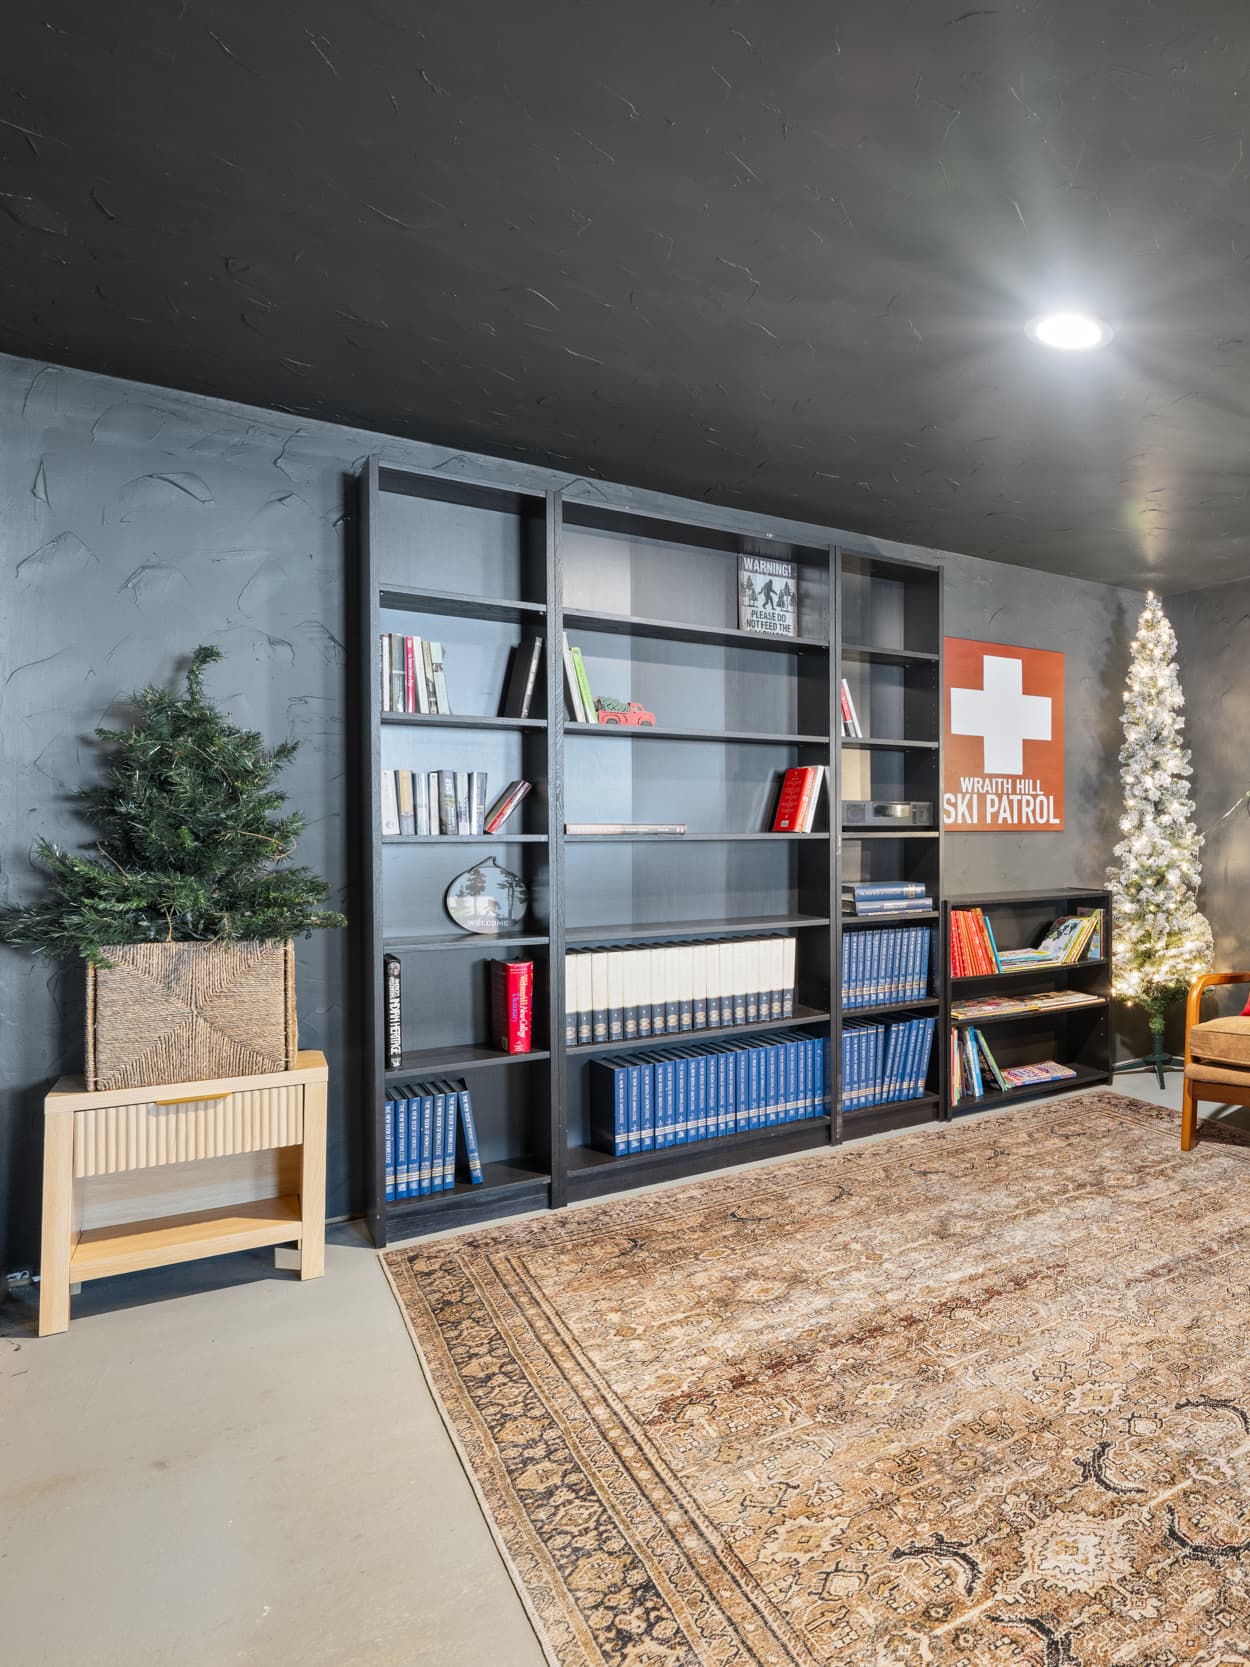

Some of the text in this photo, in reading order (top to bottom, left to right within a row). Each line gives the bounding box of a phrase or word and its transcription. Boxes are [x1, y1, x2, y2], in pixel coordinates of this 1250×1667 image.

[744, 558, 792, 577] WARNING!
[752, 610, 786, 622] PLEASE DO
[746, 618, 760, 629] NOT
[760, 620, 778, 631] FEED
[778, 624, 792, 633] THE
[960, 776, 1044, 794] WRAITH HILL
[943, 792, 1060, 824] SKI PATROL
[468, 919, 509, 928] WELCOME
[390, 998, 400, 1022] INDIAN
[390, 1022, 402, 1056] HERITAGE
